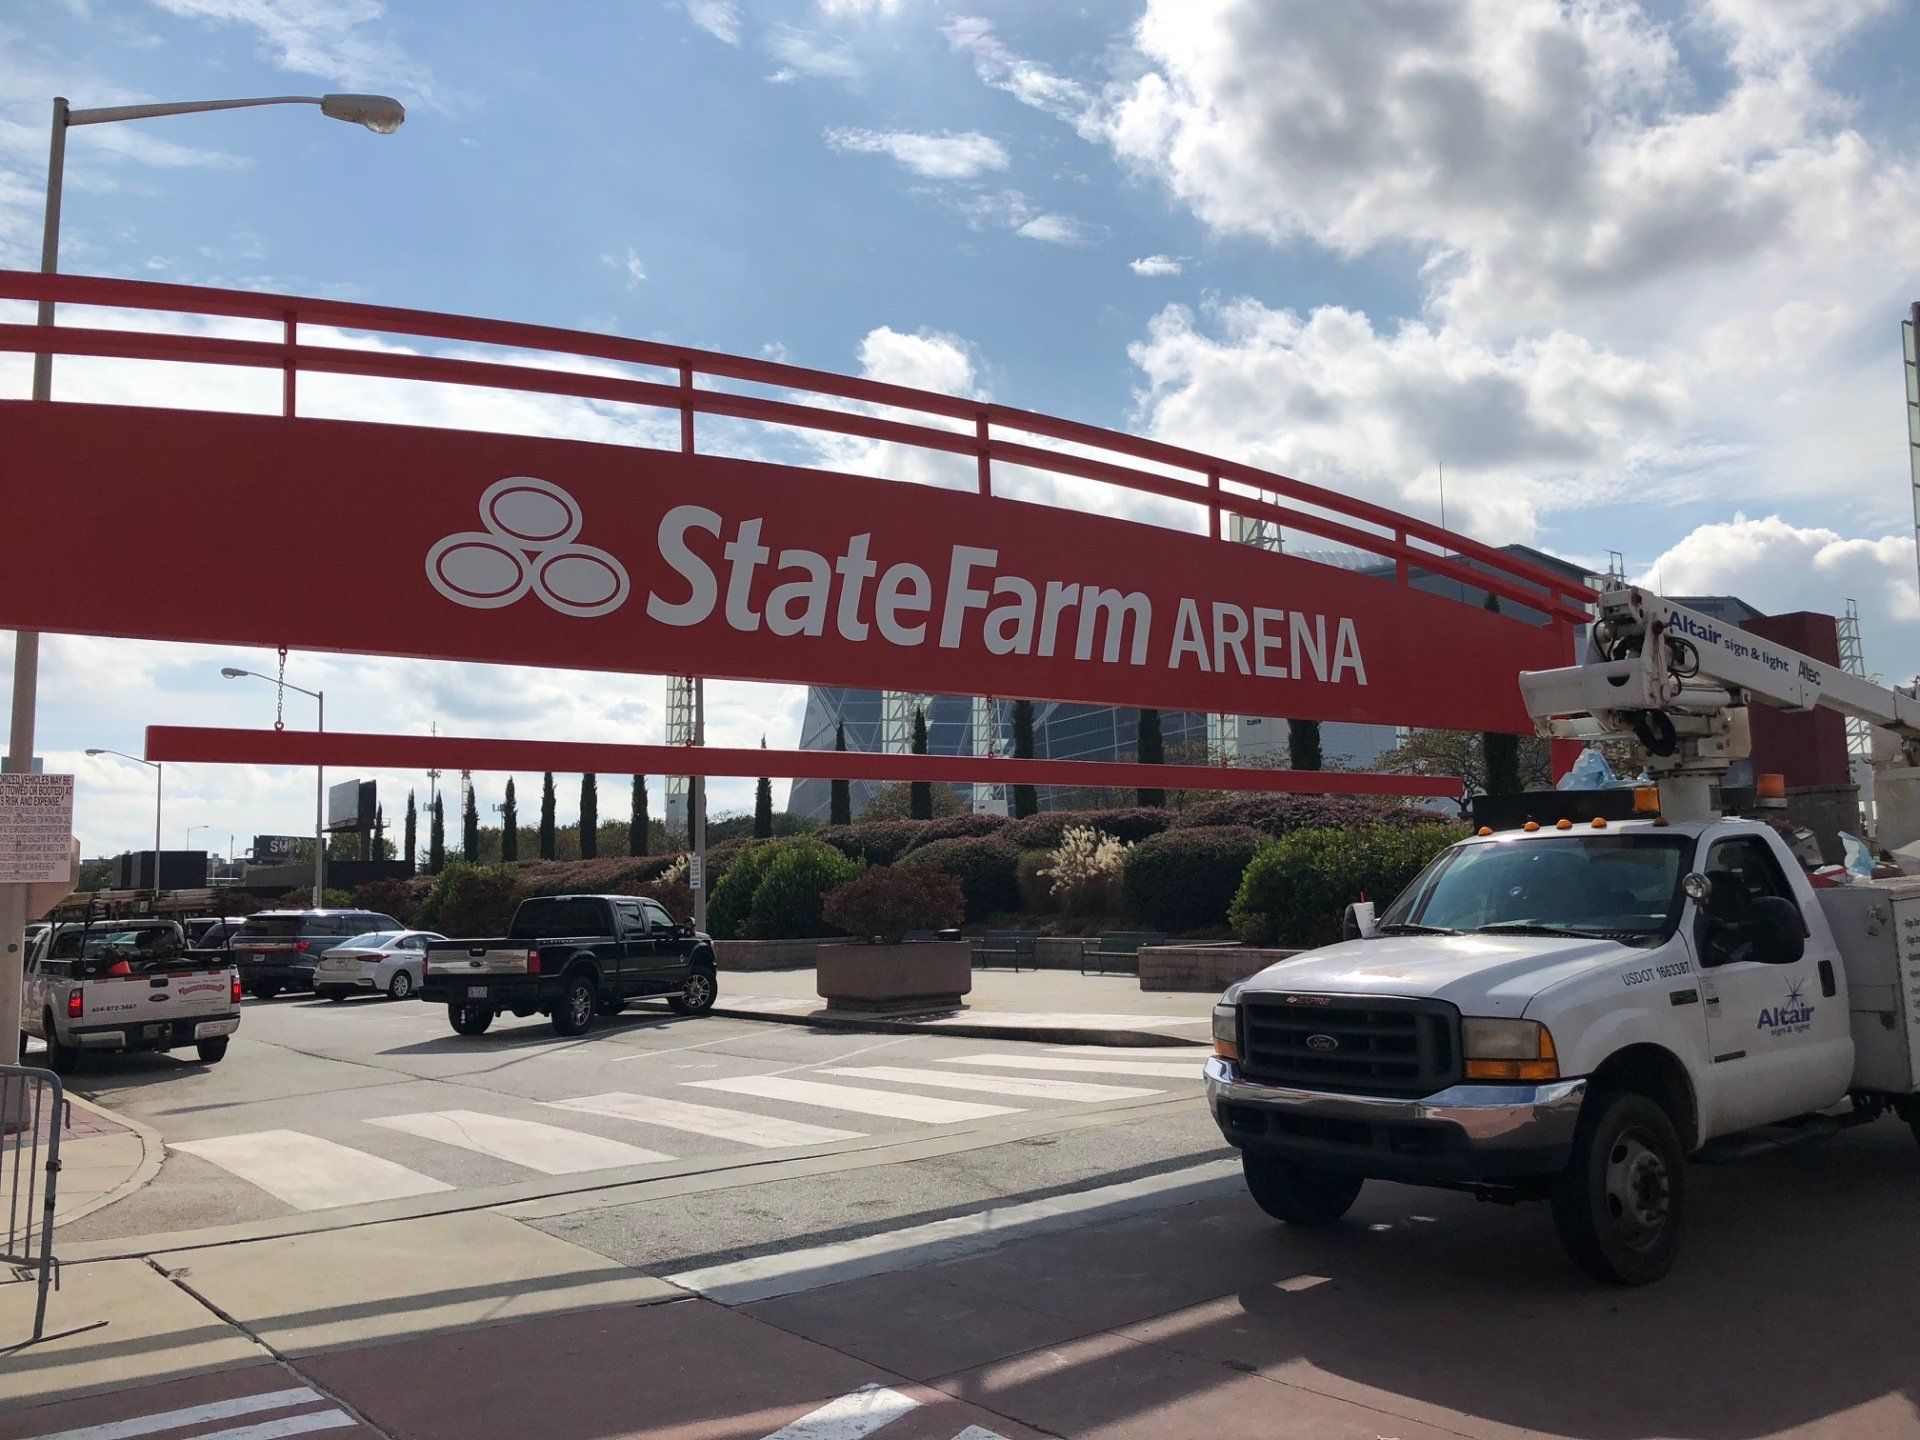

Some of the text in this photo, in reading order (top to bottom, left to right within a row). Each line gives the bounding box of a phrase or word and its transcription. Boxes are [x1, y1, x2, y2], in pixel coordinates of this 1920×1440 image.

[646, 505, 1368, 686] State Farm ARENA
[1668, 611, 1790, 672] Altair sign & light
[1798, 660, 1821, 686] Altec
[21, 775, 49, 785] VEHICLES
[50, 775, 62, 785] MAY
[63, 776, 71, 786] BE
[65, 786, 73, 796] AT
[20, 796, 33, 806] AND
[1621, 961, 1690, 986] USDOT 1663387
[1757, 1002, 1815, 1030] Altair
